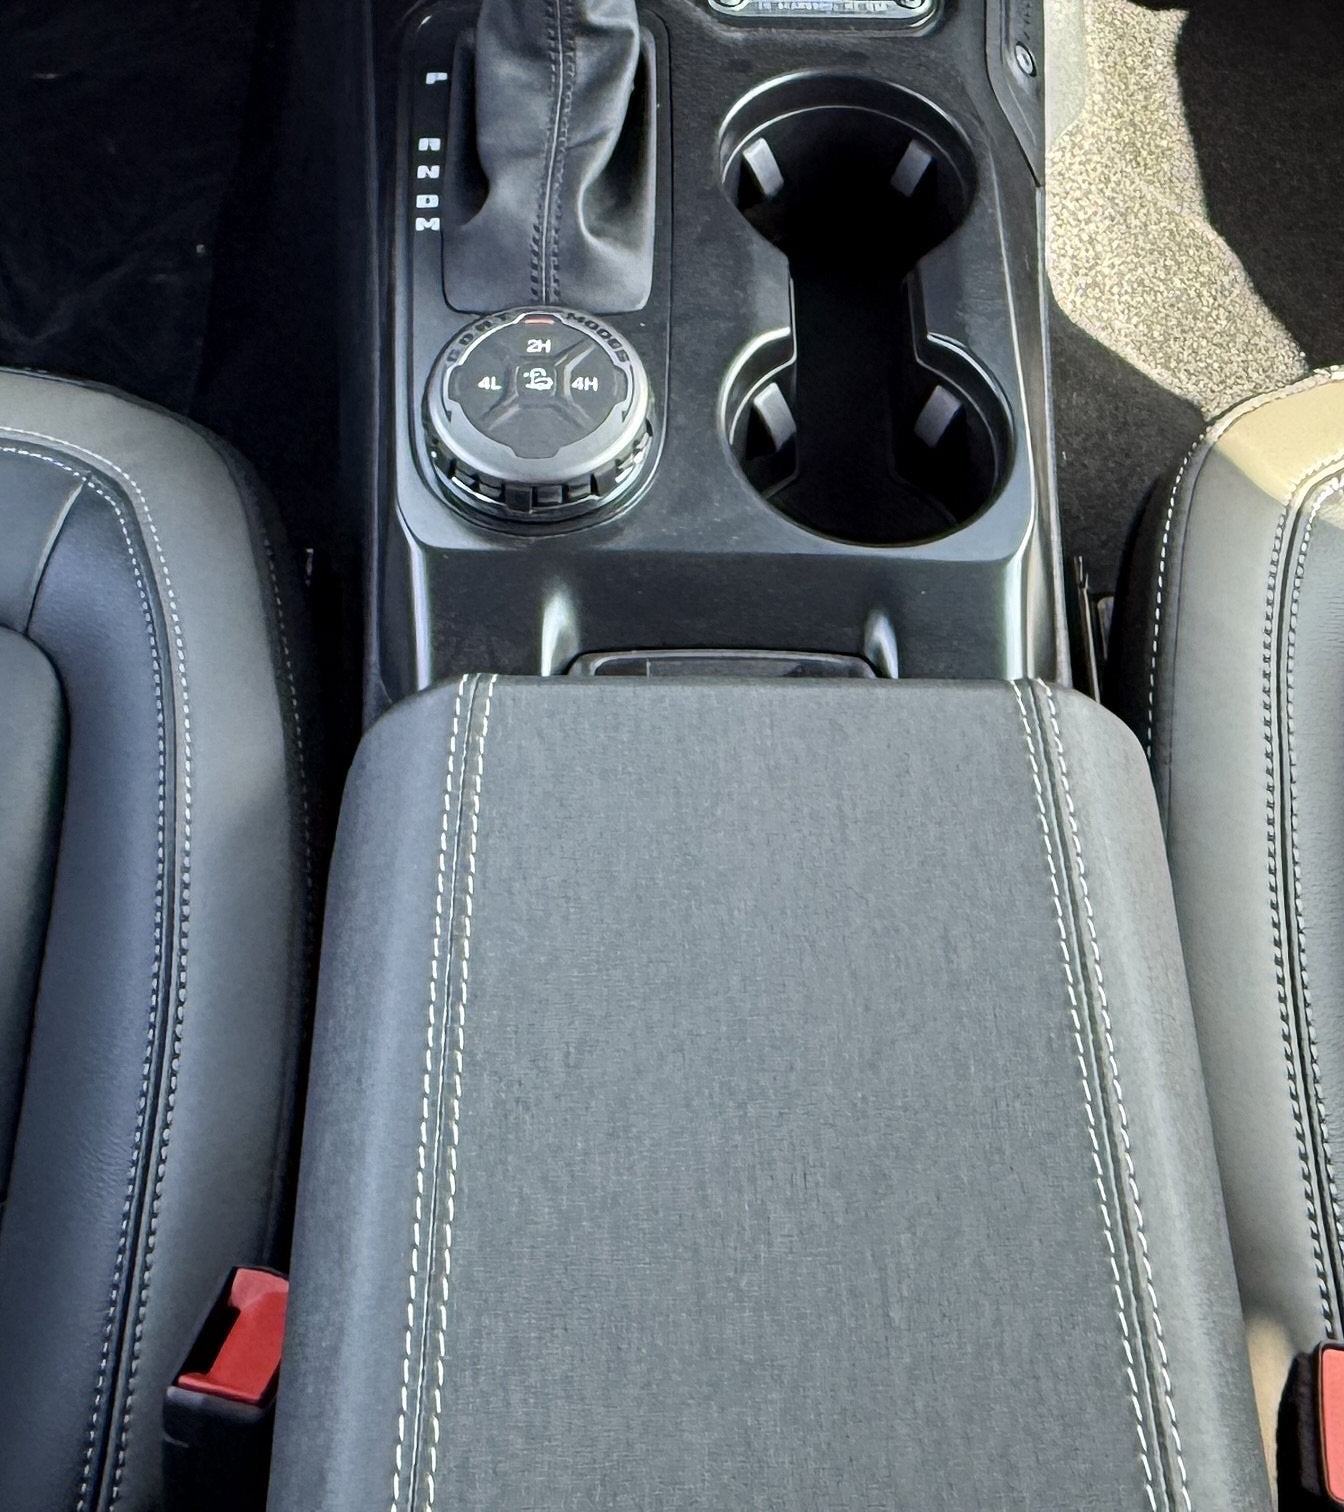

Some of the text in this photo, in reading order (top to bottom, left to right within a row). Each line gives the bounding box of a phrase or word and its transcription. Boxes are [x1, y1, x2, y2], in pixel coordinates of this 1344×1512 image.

[417, 165, 440, 179] N
[416, 194, 439, 208] D
[415, 217, 441, 231] M
[526, 339, 552, 354] 2H
[477, 375, 503, 391] 4L
[572, 375, 599, 392] 4H
